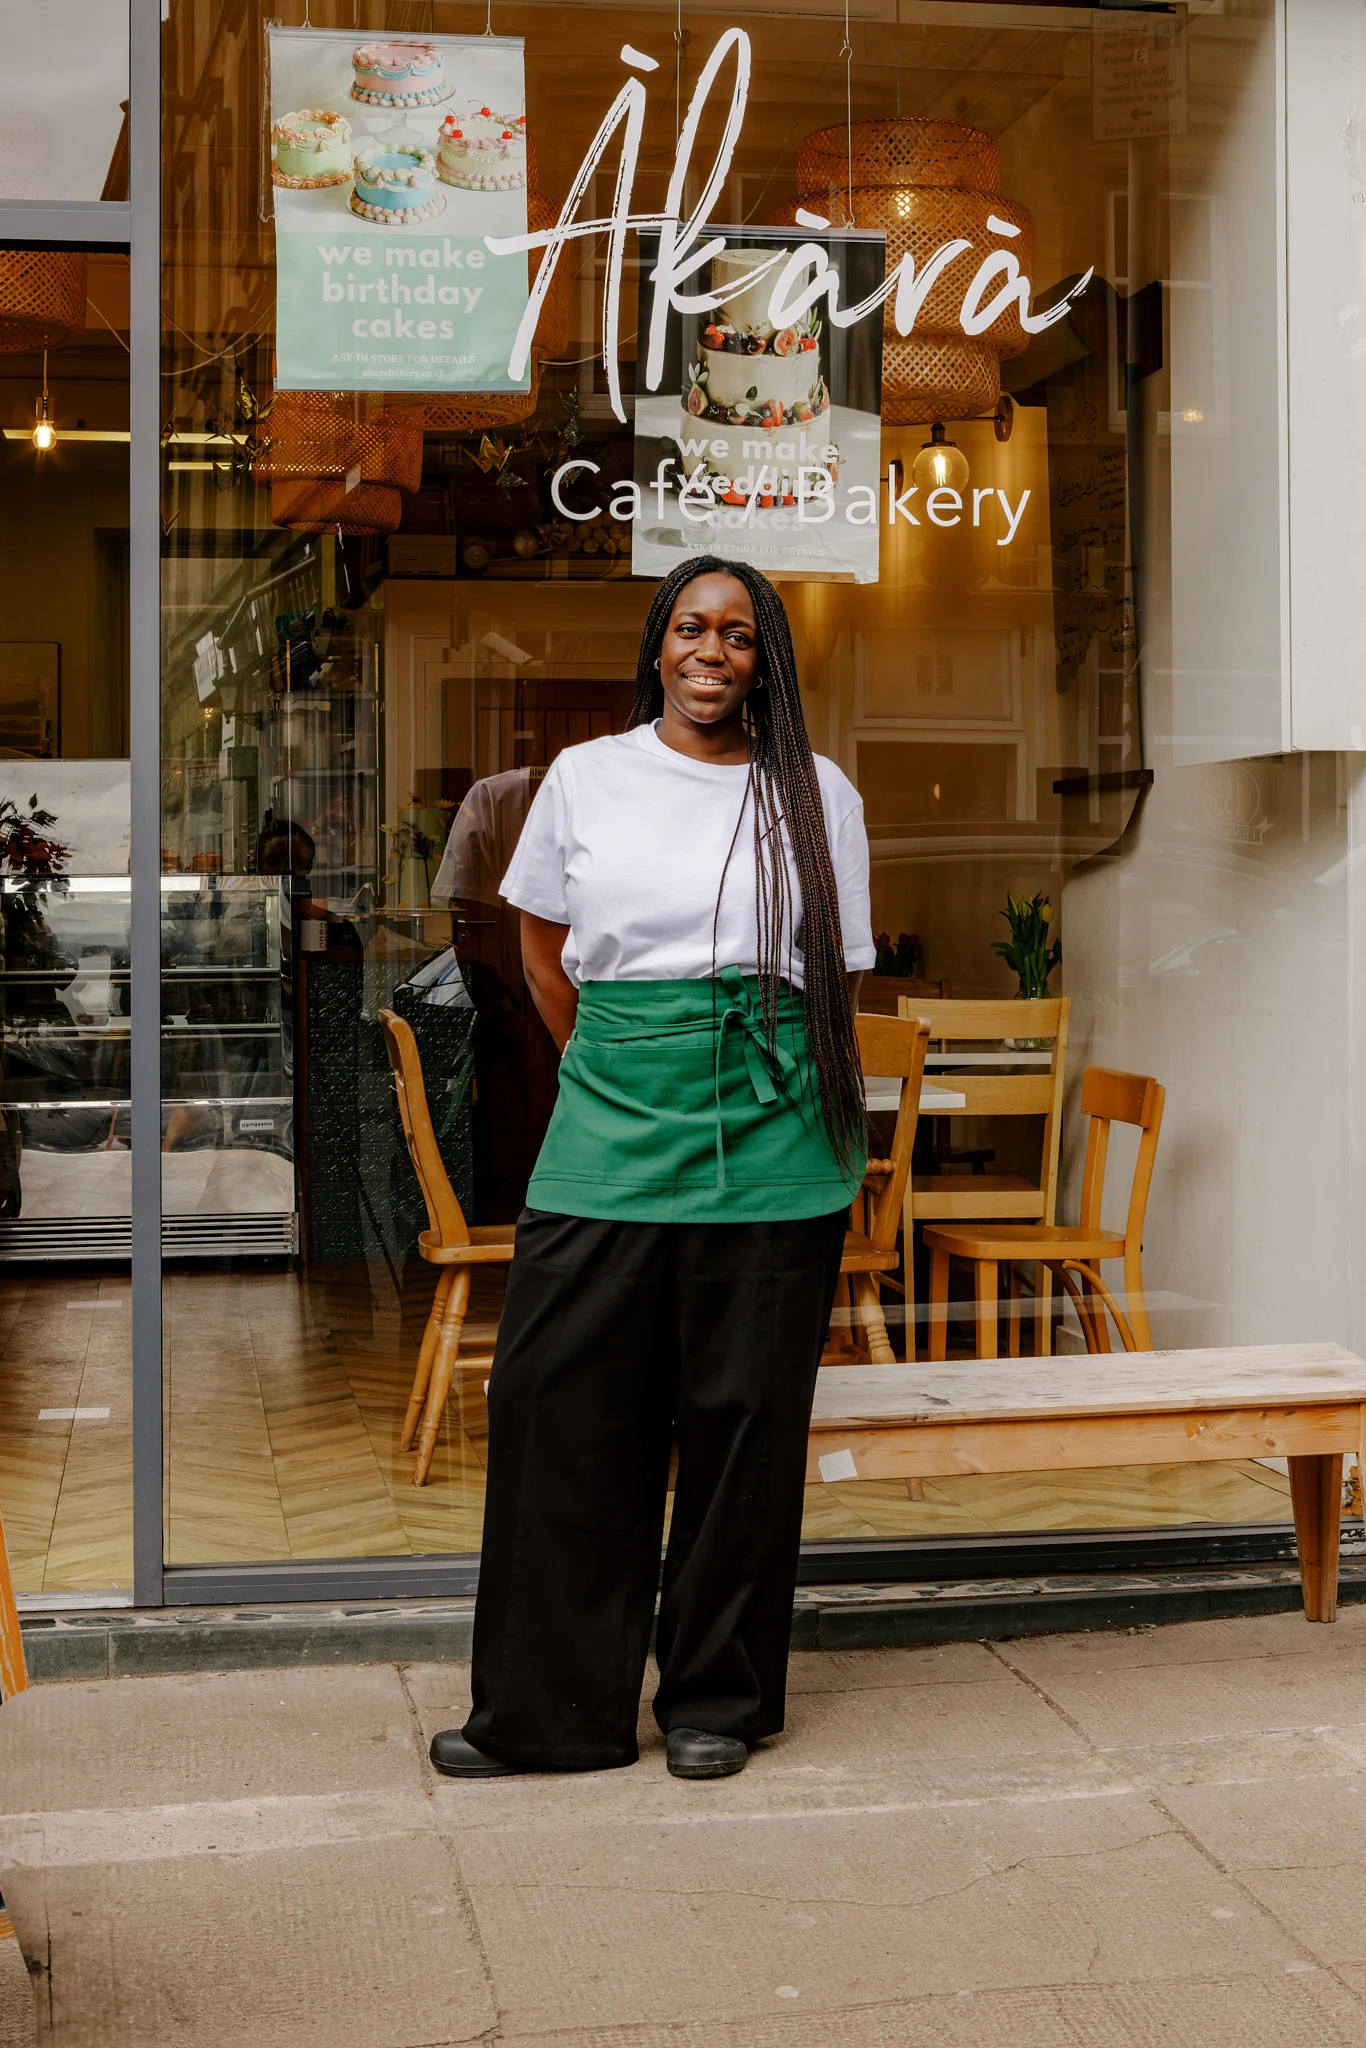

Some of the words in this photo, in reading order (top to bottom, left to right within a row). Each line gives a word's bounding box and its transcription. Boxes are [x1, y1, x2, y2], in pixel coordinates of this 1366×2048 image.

[317, 245, 372, 265] we
[386, 238, 486, 269] make
[322, 271, 484, 314] birthday
[352, 308, 455, 340] cakes
[332, 353, 353, 362] ASK
[356, 354, 368, 362] IN
[371, 355, 404, 363] STORE
[408, 355, 428, 364] FOR
[431, 355, 476, 364] DETAILS
[674, 437, 730, 459] we
[742, 431, 840, 463] make
[551, 458, 715, 523] Café
[799, 459, 1032, 546] Bakery
[707, 502, 806, 532] cakes
[686, 544, 706, 553] ASK
[708, 544, 721, 553] IN
[724, 544, 757, 554] STORE
[760, 545, 780, 555] FOR
[782, 546, 826, 557] DETAILS
